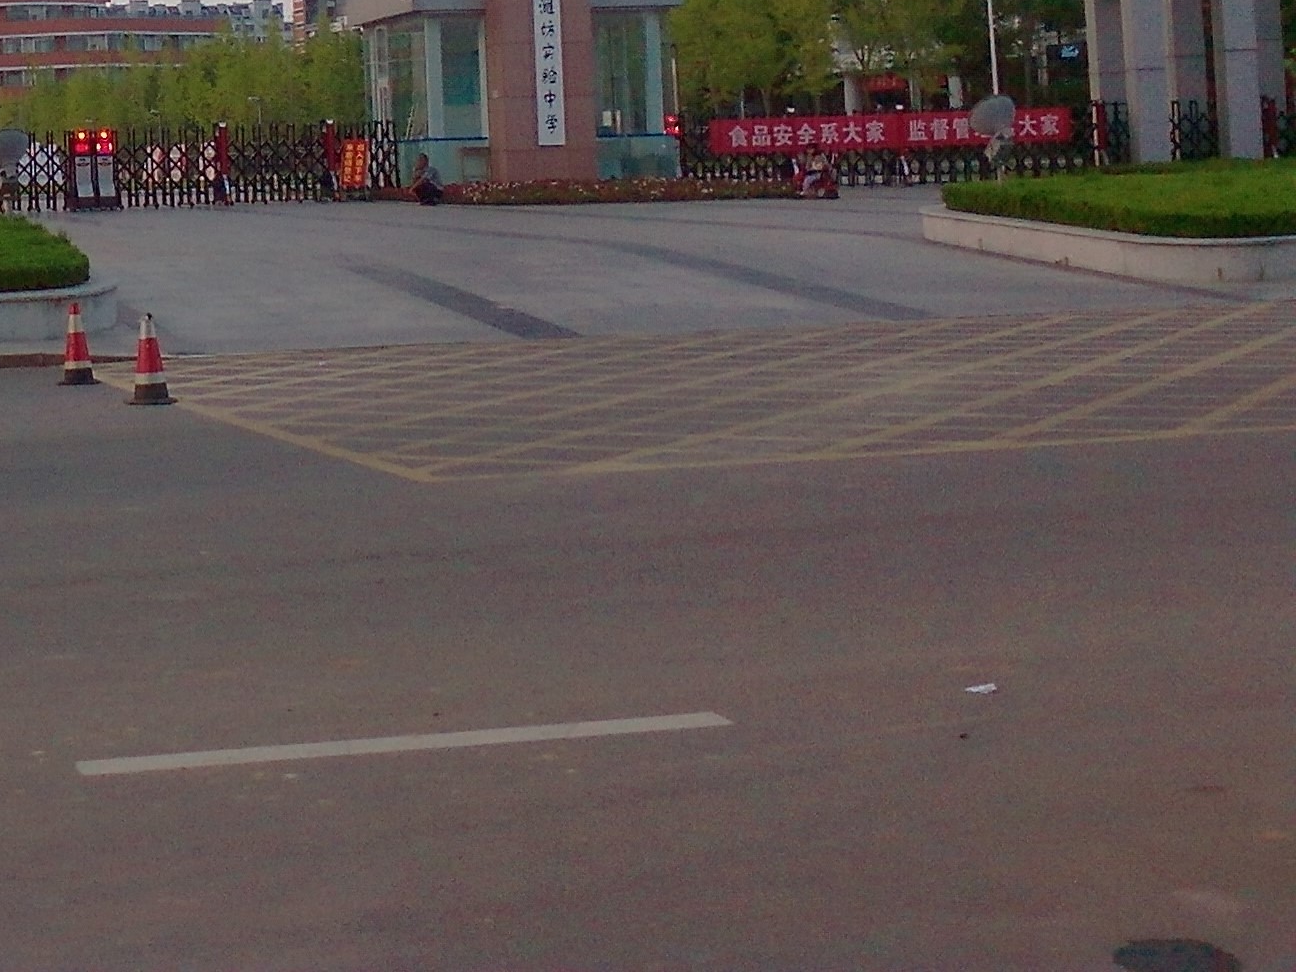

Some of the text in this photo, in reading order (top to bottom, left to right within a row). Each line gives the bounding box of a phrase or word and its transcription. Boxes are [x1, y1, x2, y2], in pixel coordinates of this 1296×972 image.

[728, 120, 885, 147] 食品安全系大家
